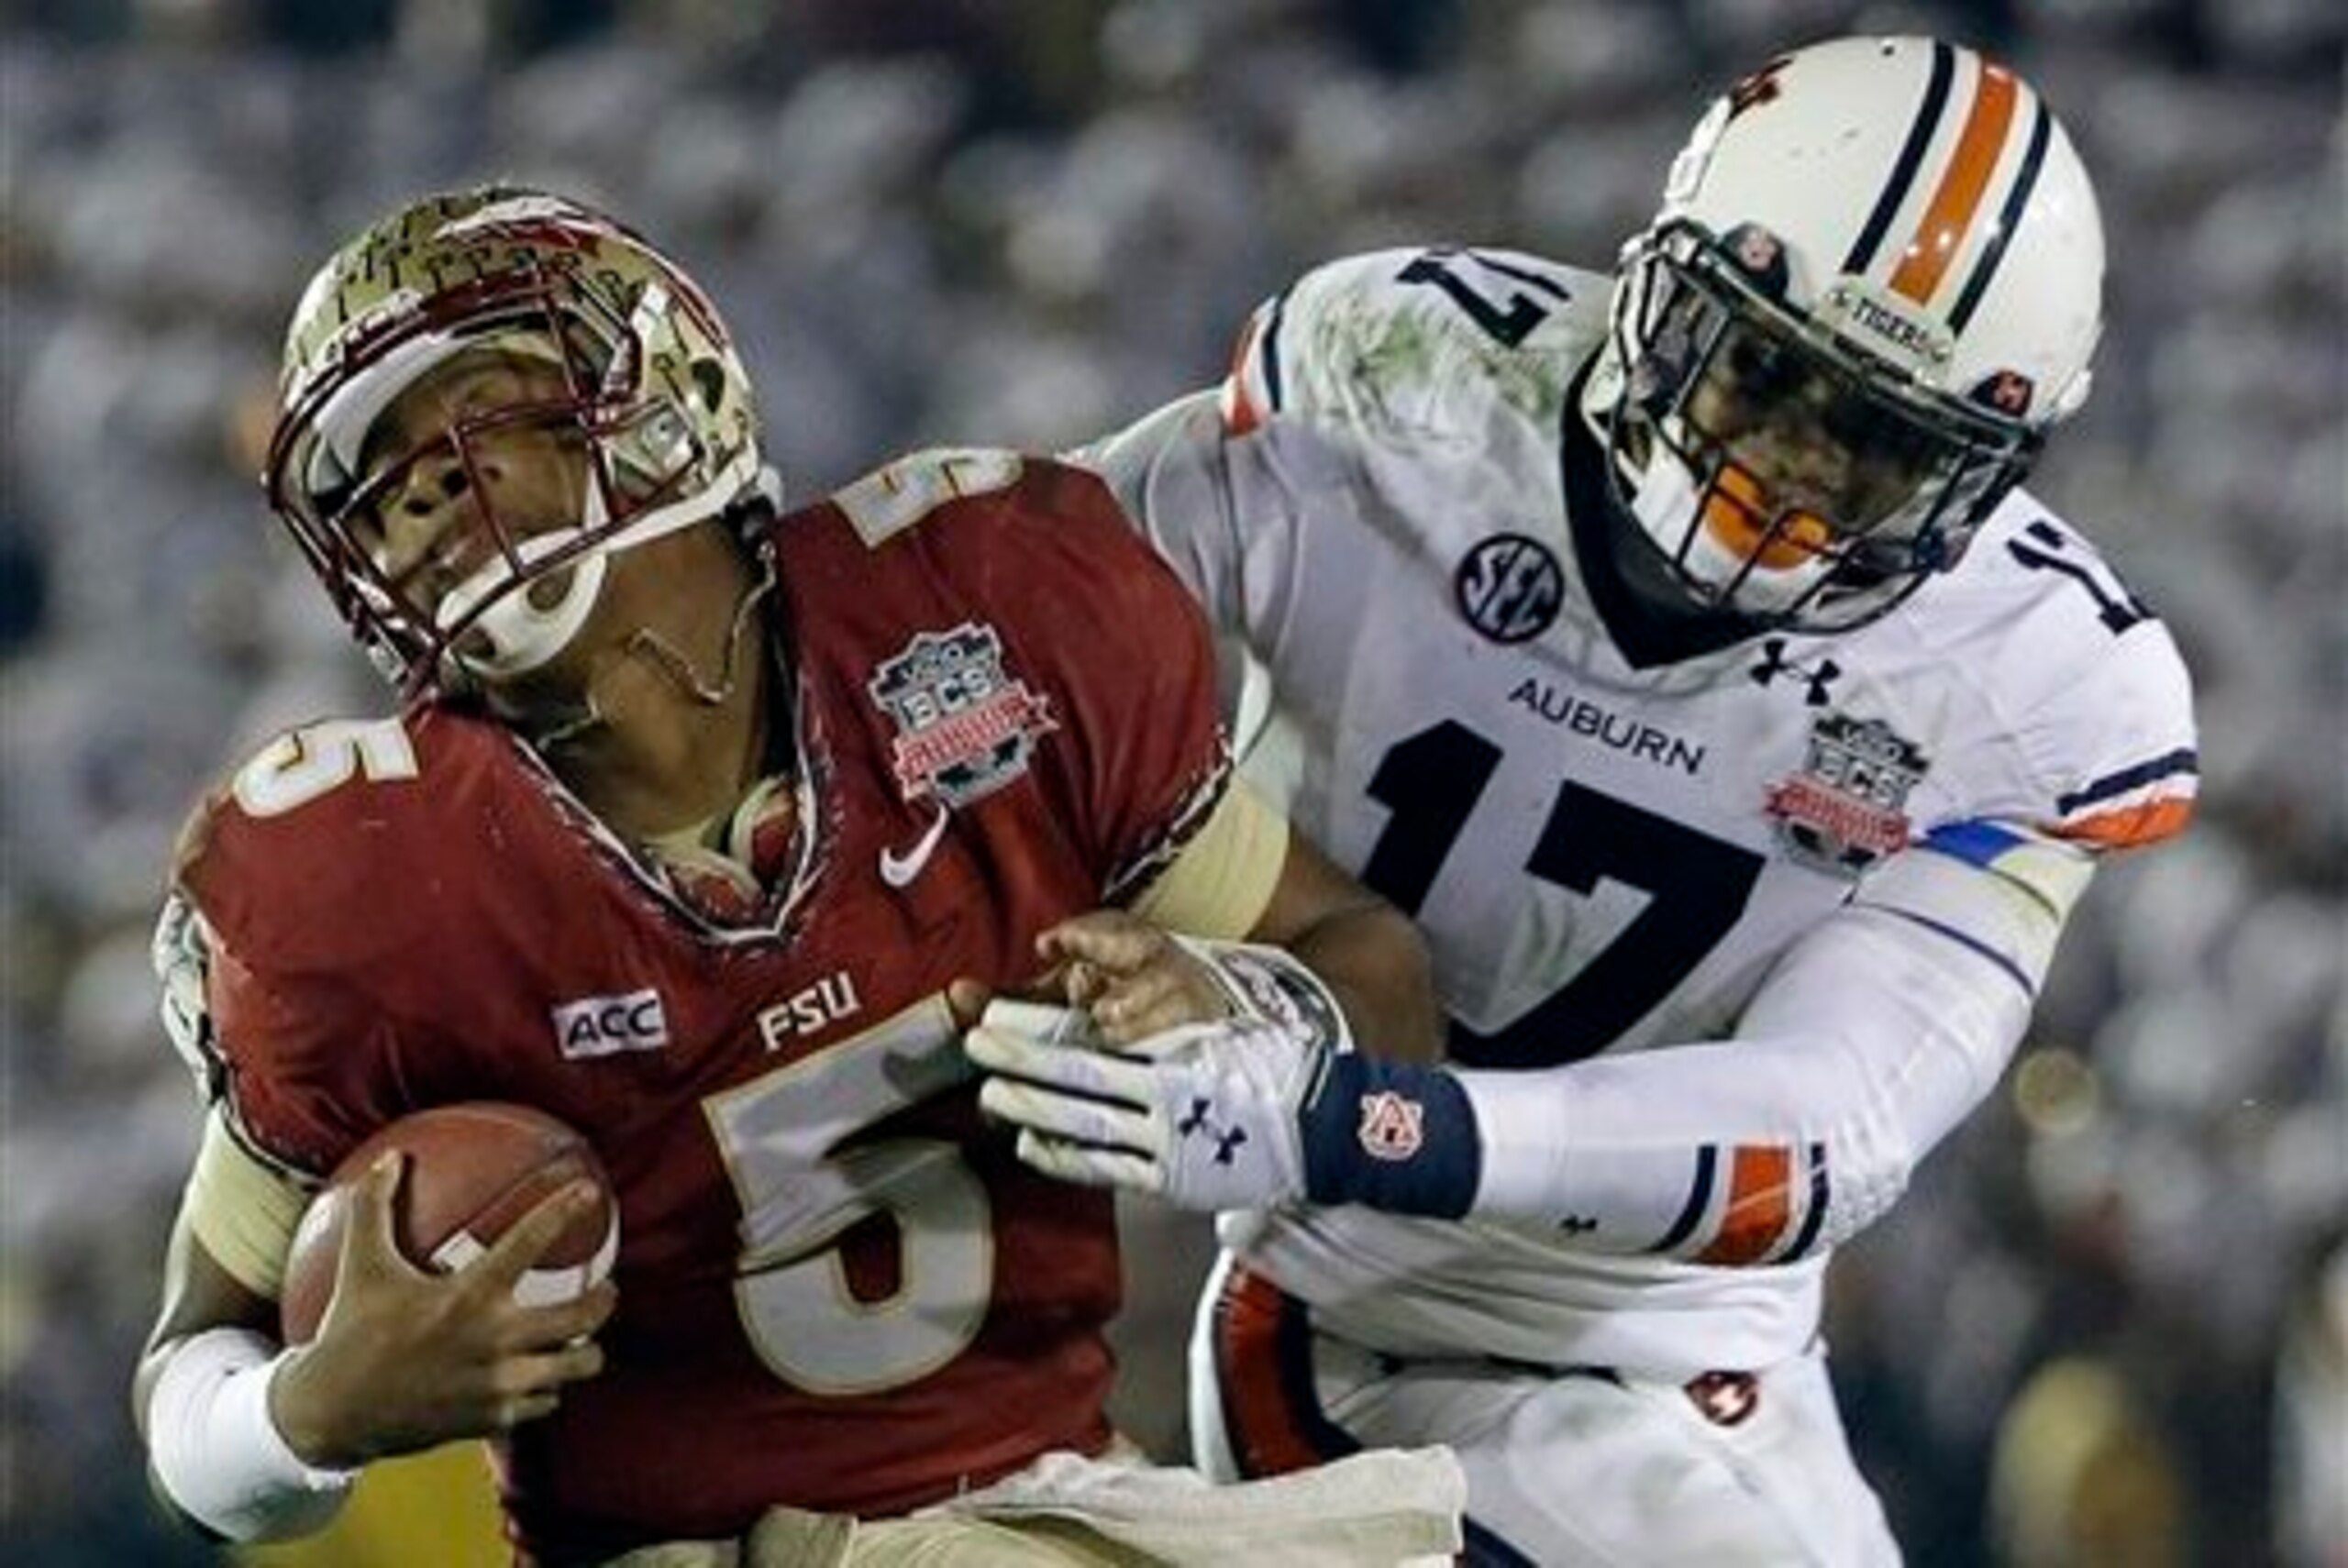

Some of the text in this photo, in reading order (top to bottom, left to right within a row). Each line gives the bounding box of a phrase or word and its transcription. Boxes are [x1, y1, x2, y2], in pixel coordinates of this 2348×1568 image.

[1462, 537, 1559, 637] SEC
[903, 668, 993, 730] BCS
[1508, 678, 1708, 775] AUBURN
[233, 715, 420, 818] 5
[1357, 718, 1767, 1070] 17
[567, 998, 662, 1050] ACC
[756, 971, 862, 1052] FSU
[700, 988, 997, 1397] 5
